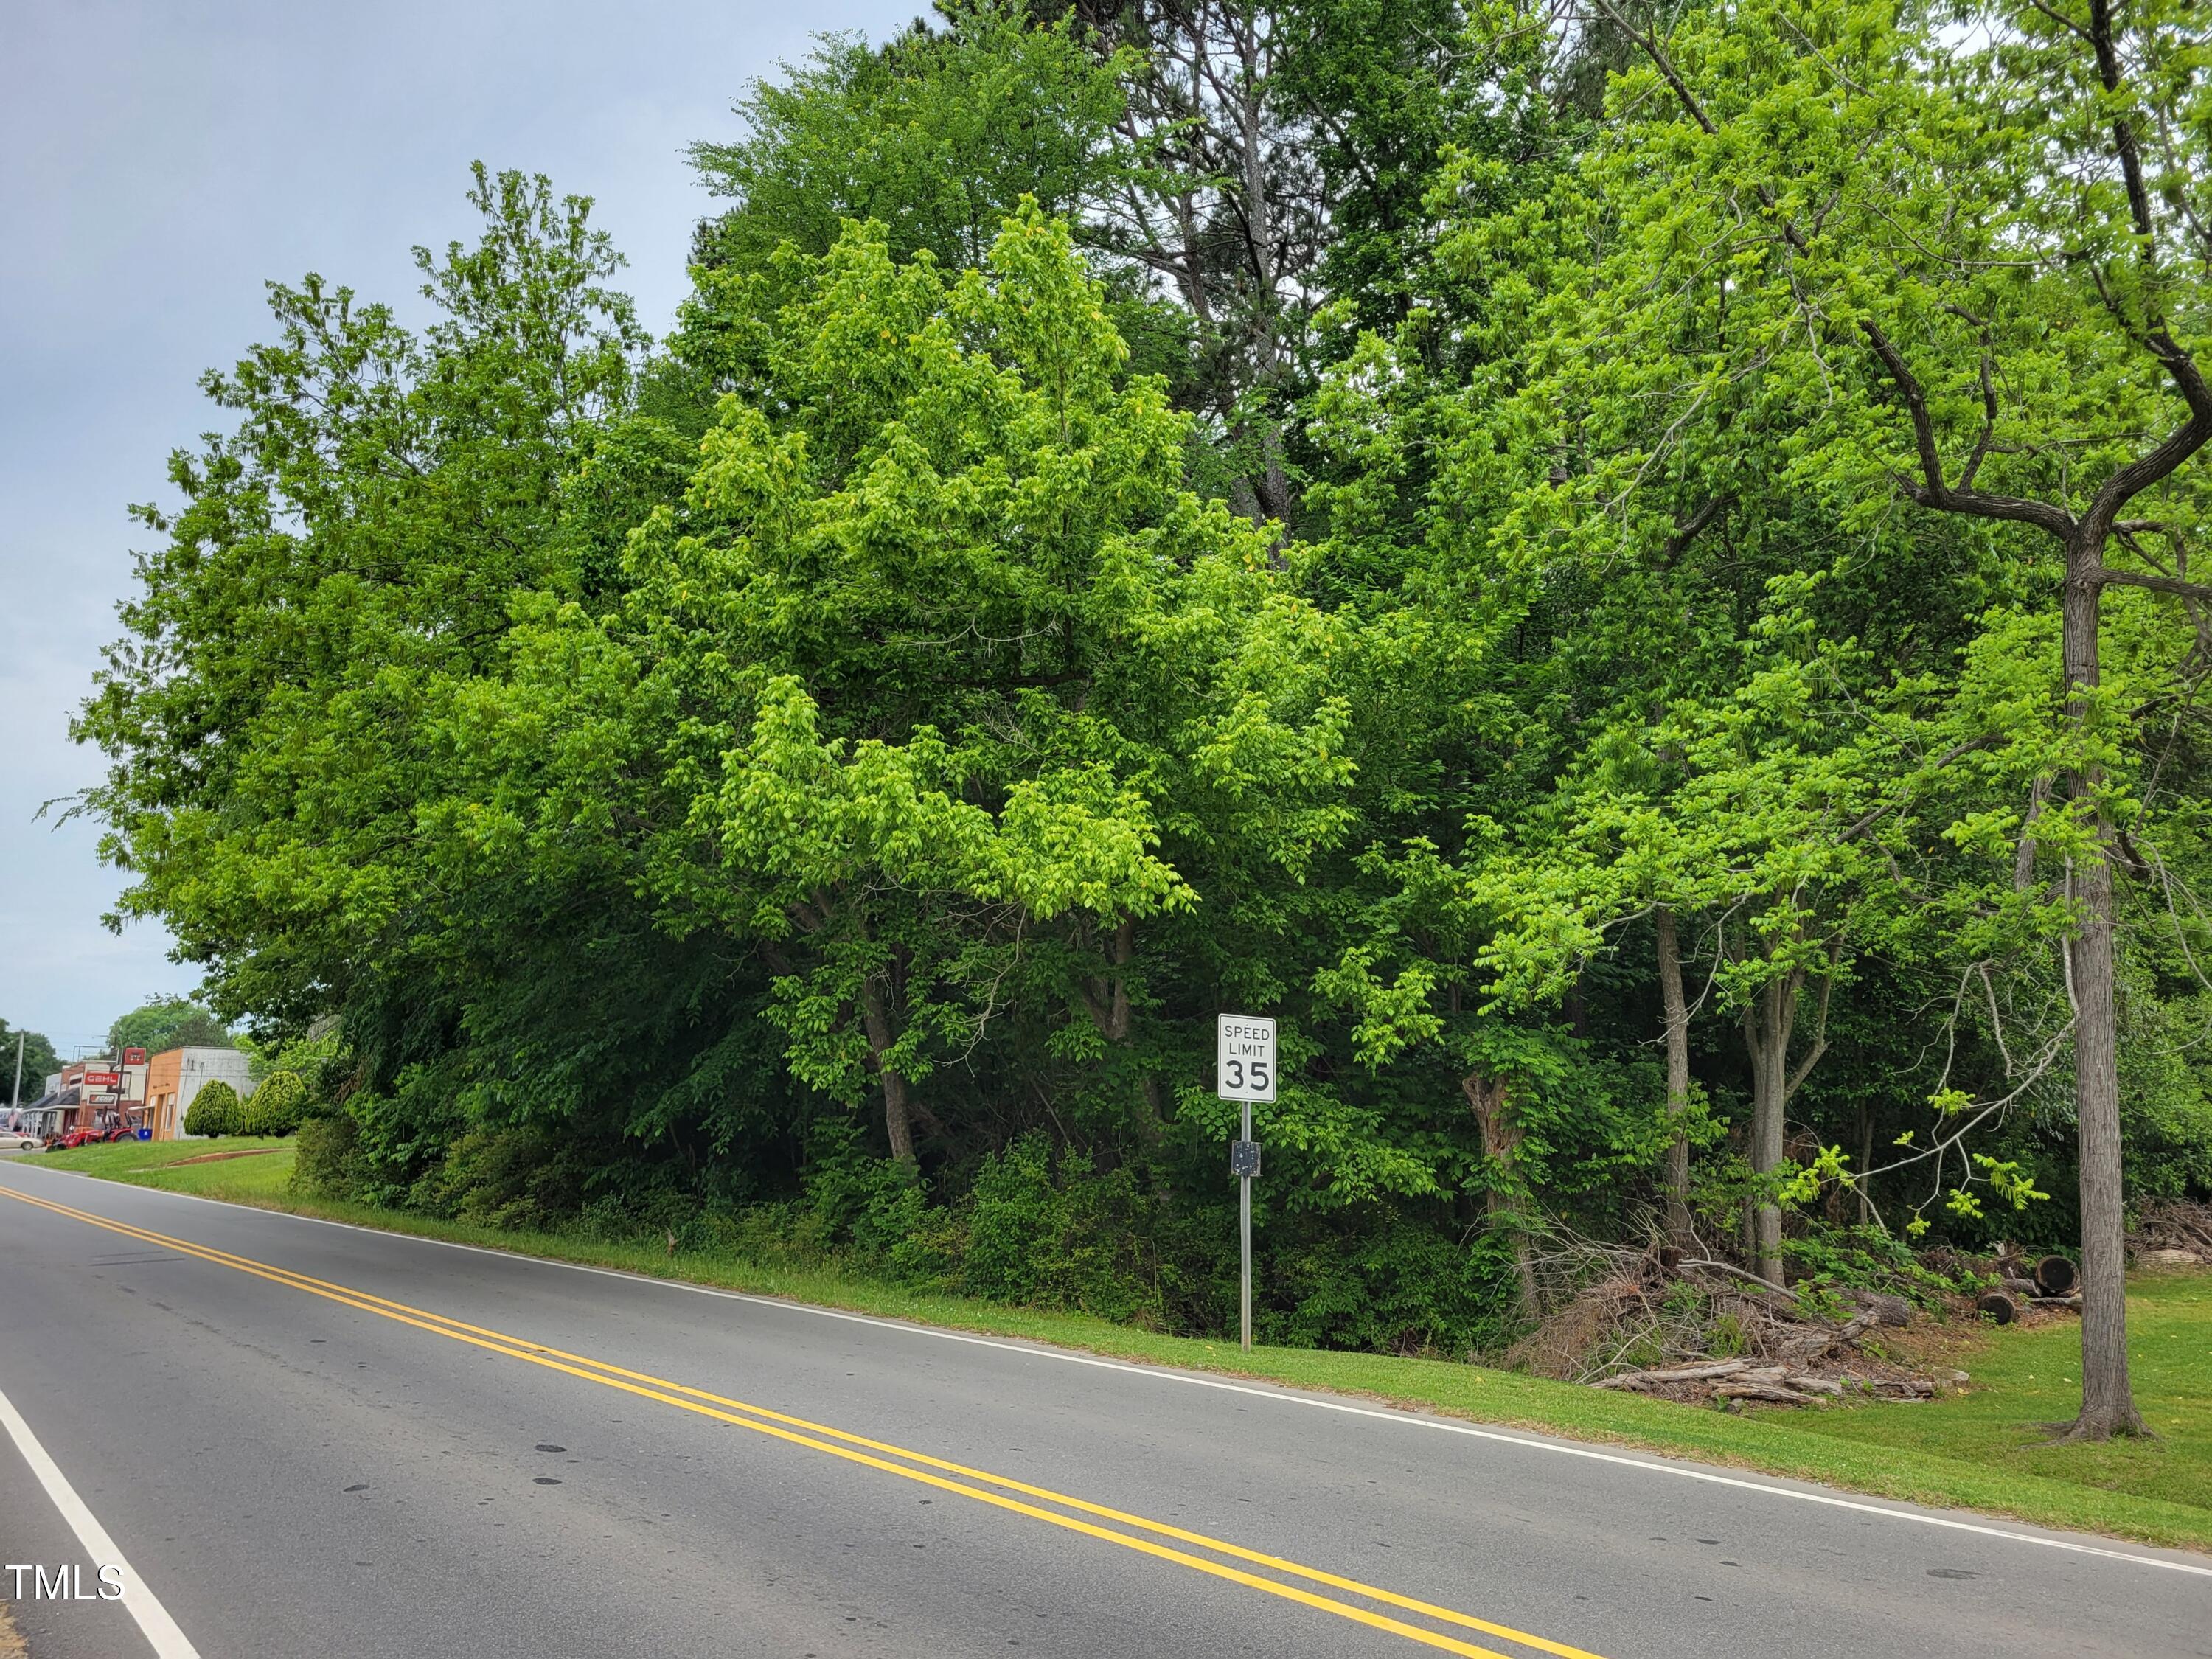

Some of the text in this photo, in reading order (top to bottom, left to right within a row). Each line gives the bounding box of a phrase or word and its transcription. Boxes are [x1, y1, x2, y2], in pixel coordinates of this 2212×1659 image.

[1225, 1025, 1270, 1040] SPEED
[1229, 1043, 1265, 1057] LIMIT
[1225, 1060, 1270, 1091] 35
